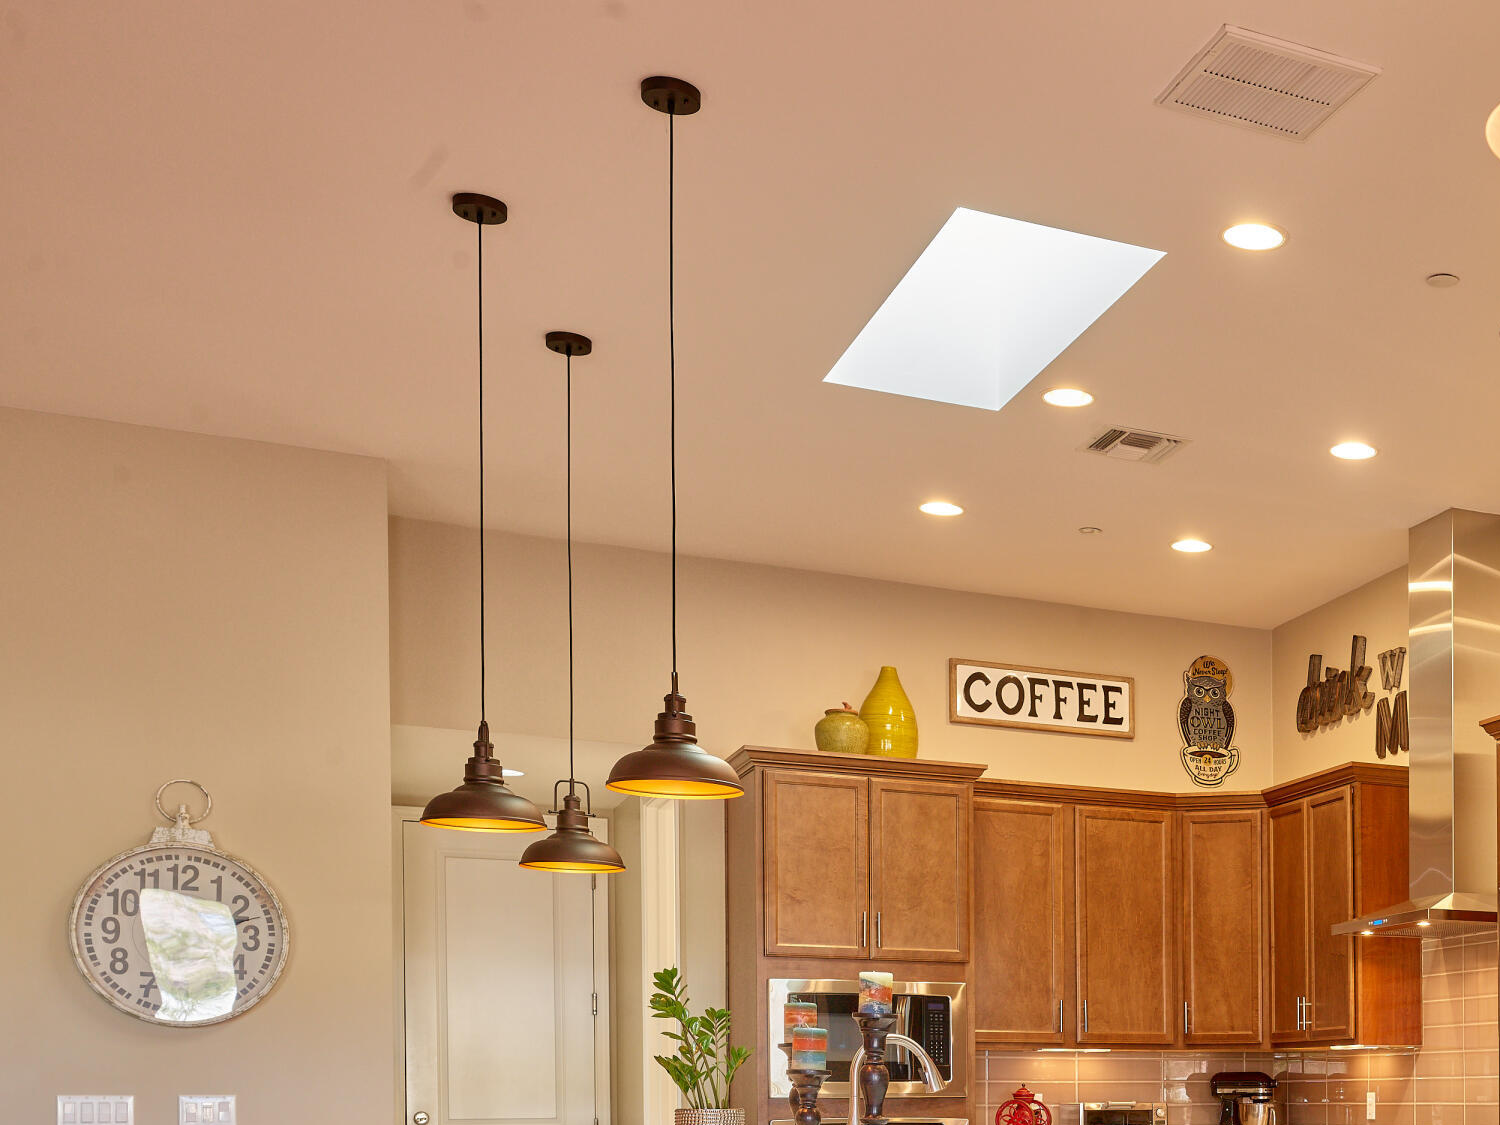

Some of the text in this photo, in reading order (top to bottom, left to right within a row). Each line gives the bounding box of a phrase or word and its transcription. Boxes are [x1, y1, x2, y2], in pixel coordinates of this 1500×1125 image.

[1192, 667, 1211, 676] Never
[963, 672, 1124, 726] COFFEE
[1194, 707, 1220, 717] NIGHT
[1190, 716, 1225, 729] OWL
[1193, 728, 1222, 737] COFFEE
[1190, 756, 1202, 764] OPEN
[1203, 756, 1212, 764] 24
[133, 867, 160, 890] 11
[166, 863, 200, 892] 12
[210, 875, 223, 902] 1
[106, 888, 140, 917] 10
[231, 894, 250, 921] 2
[101, 916, 121, 944] 9
[242, 925, 261, 952] 3
[109, 947, 129, 975] 8
